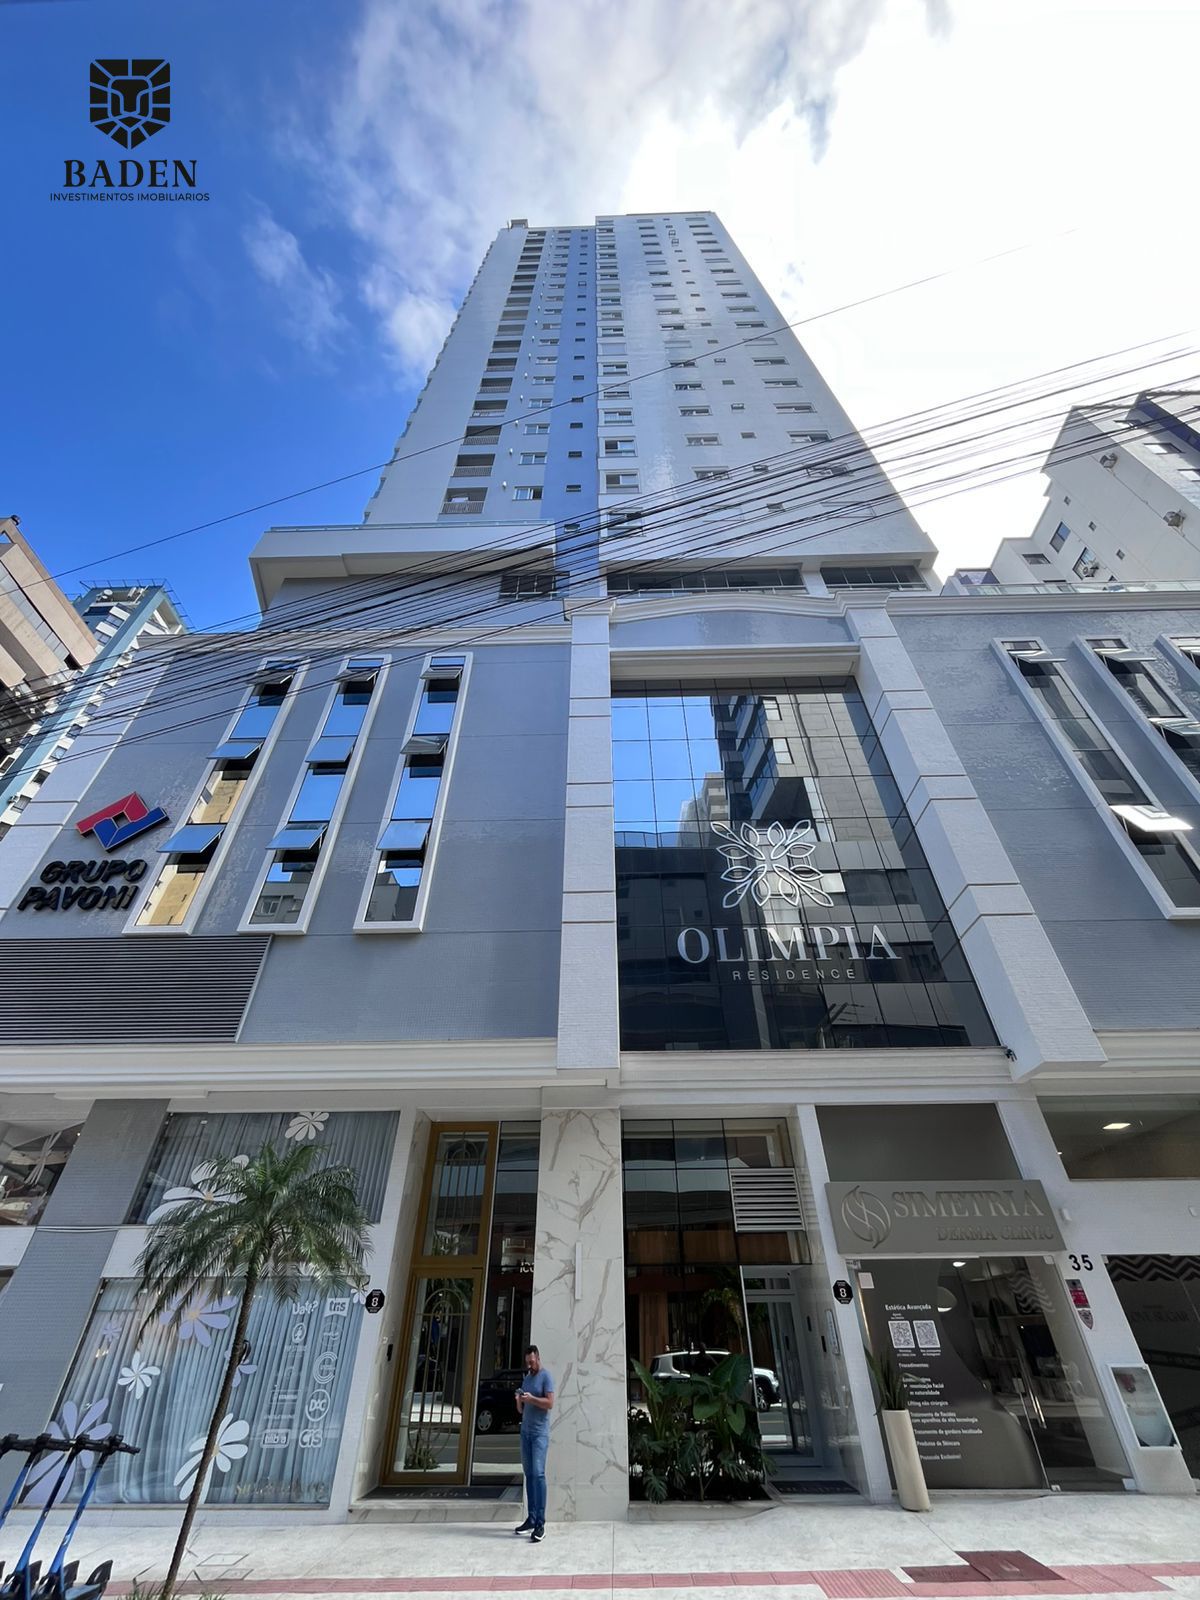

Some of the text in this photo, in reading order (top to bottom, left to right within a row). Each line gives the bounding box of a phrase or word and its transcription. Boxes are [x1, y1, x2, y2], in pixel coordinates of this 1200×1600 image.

[39, 858, 149, 885] GRUPO
[17, 885, 139, 911] PAVONI
[677, 924, 902, 964] OLIMPIA
[733, 968, 857, 981] RESIDENCE
[891, 1189, 1044, 1218] SIMETRIA
[937, 1225, 1054, 1241] DERMA CLINIC
[1068, 1254, 1094, 1271] 35
[839, 1288, 847, 1298] 8
[371, 1297, 379, 1307] 8
